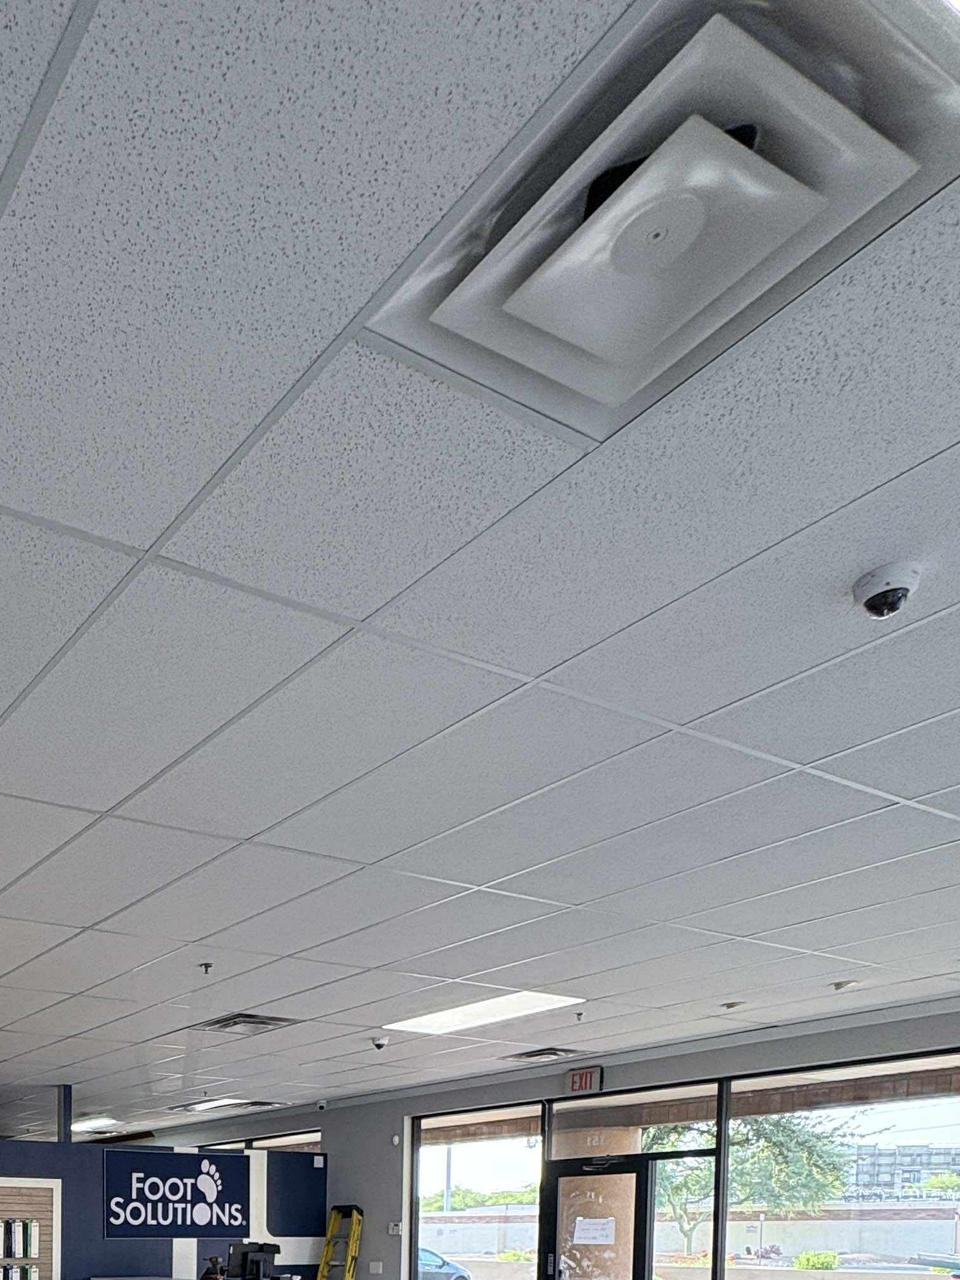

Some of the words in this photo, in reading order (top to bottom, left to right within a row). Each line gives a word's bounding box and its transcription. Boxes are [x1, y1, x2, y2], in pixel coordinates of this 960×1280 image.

[571, 1071, 595, 1092] EXIT
[131, 1172, 195, 1201] FOOT
[109, 1197, 242, 1226] SOLUTIONS
